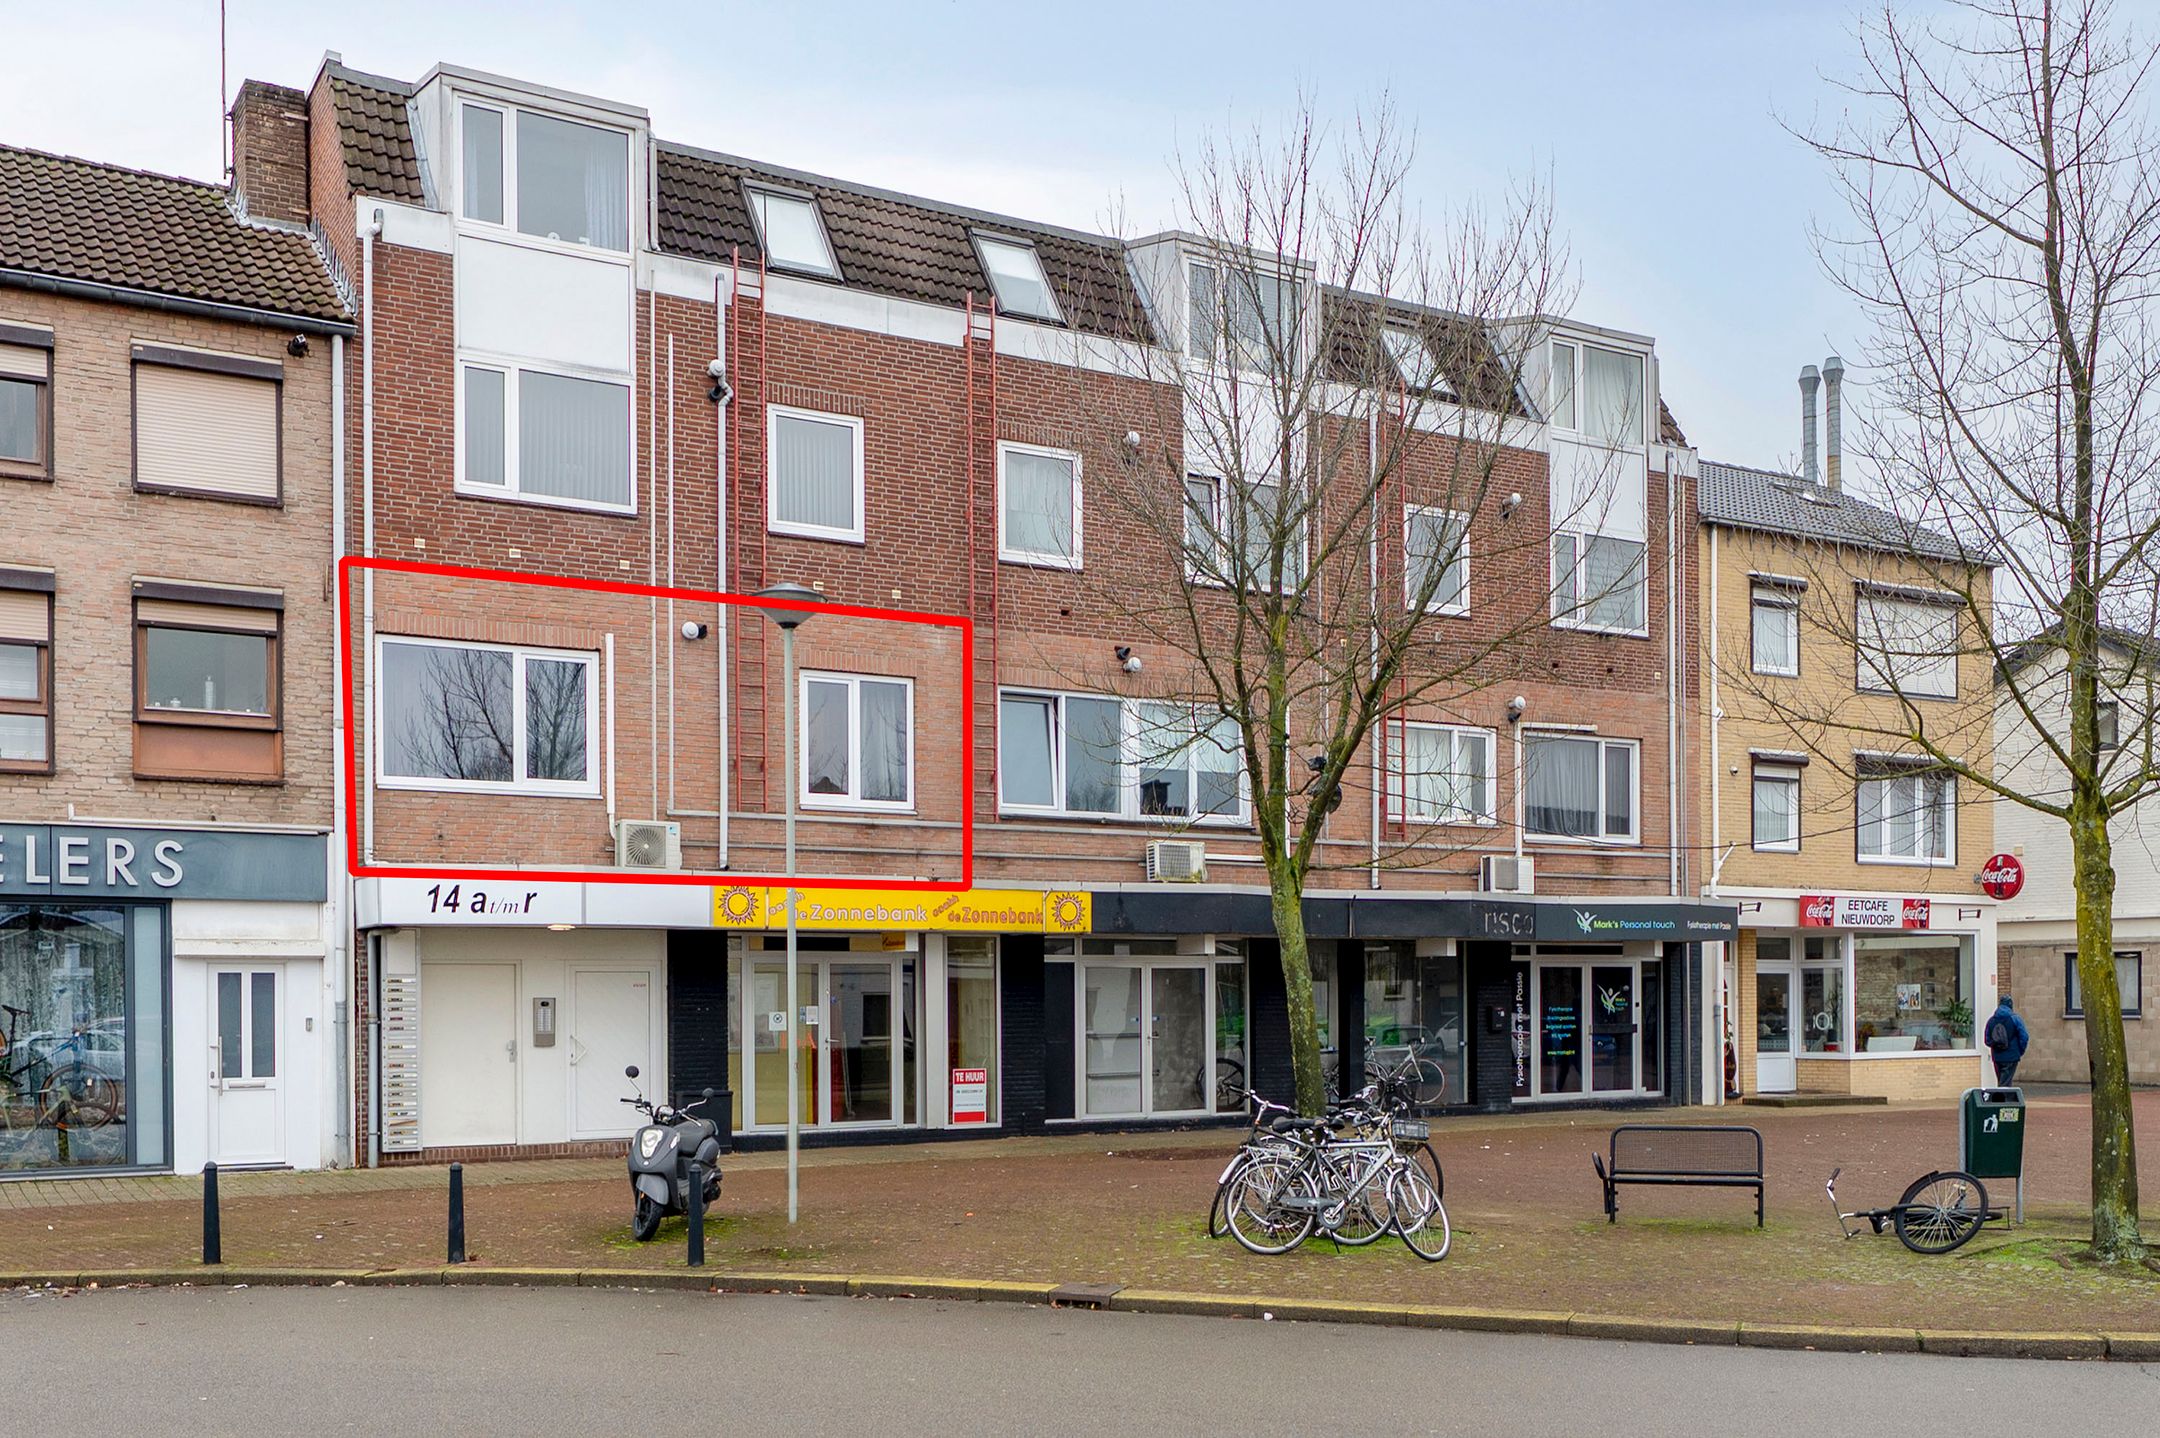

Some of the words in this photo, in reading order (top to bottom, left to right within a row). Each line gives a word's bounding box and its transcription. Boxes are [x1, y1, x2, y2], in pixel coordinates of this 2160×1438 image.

[0, 835, 184, 887] LERS
[428, 884, 460, 913] 14
[1848, 900, 1889, 911] EETCAFE
[810, 904, 928, 921] Zonnebank
[948, 910, 960, 922] de
[961, 907, 1043, 924] Zonnebank
[1841, 914, 1896, 925] NIEUWDORP
[1593, 920, 1619, 929] Mark's
[1619, 920, 1652, 929] Personal
[1653, 920, 1675, 929] touch
[956, 1072, 964, 1082] TE
[965, 1072, 984, 1082] HUUR
